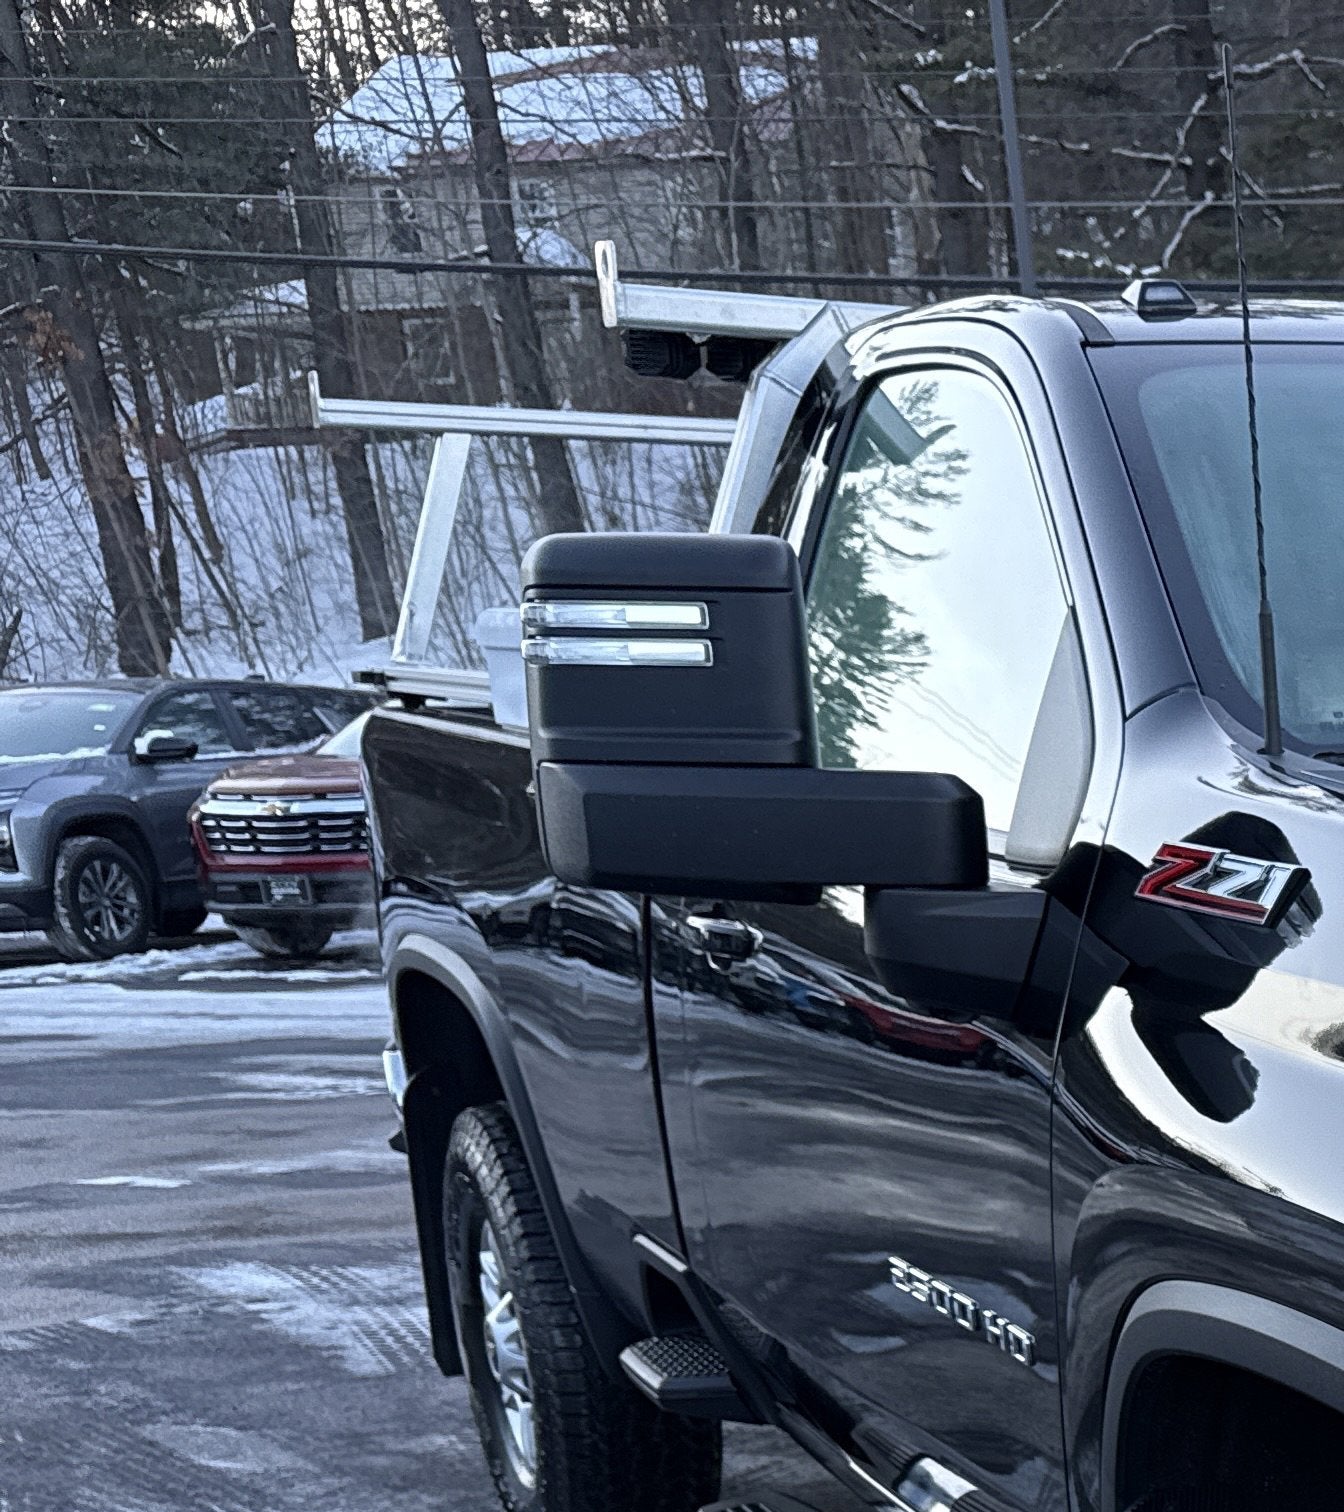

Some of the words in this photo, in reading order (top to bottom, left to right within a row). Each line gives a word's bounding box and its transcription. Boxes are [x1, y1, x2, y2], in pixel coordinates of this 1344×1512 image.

[1135, 841, 1304, 925] Z71
[888, 1256, 979, 1332] 2500
[983, 1310, 1036, 1367] HD
